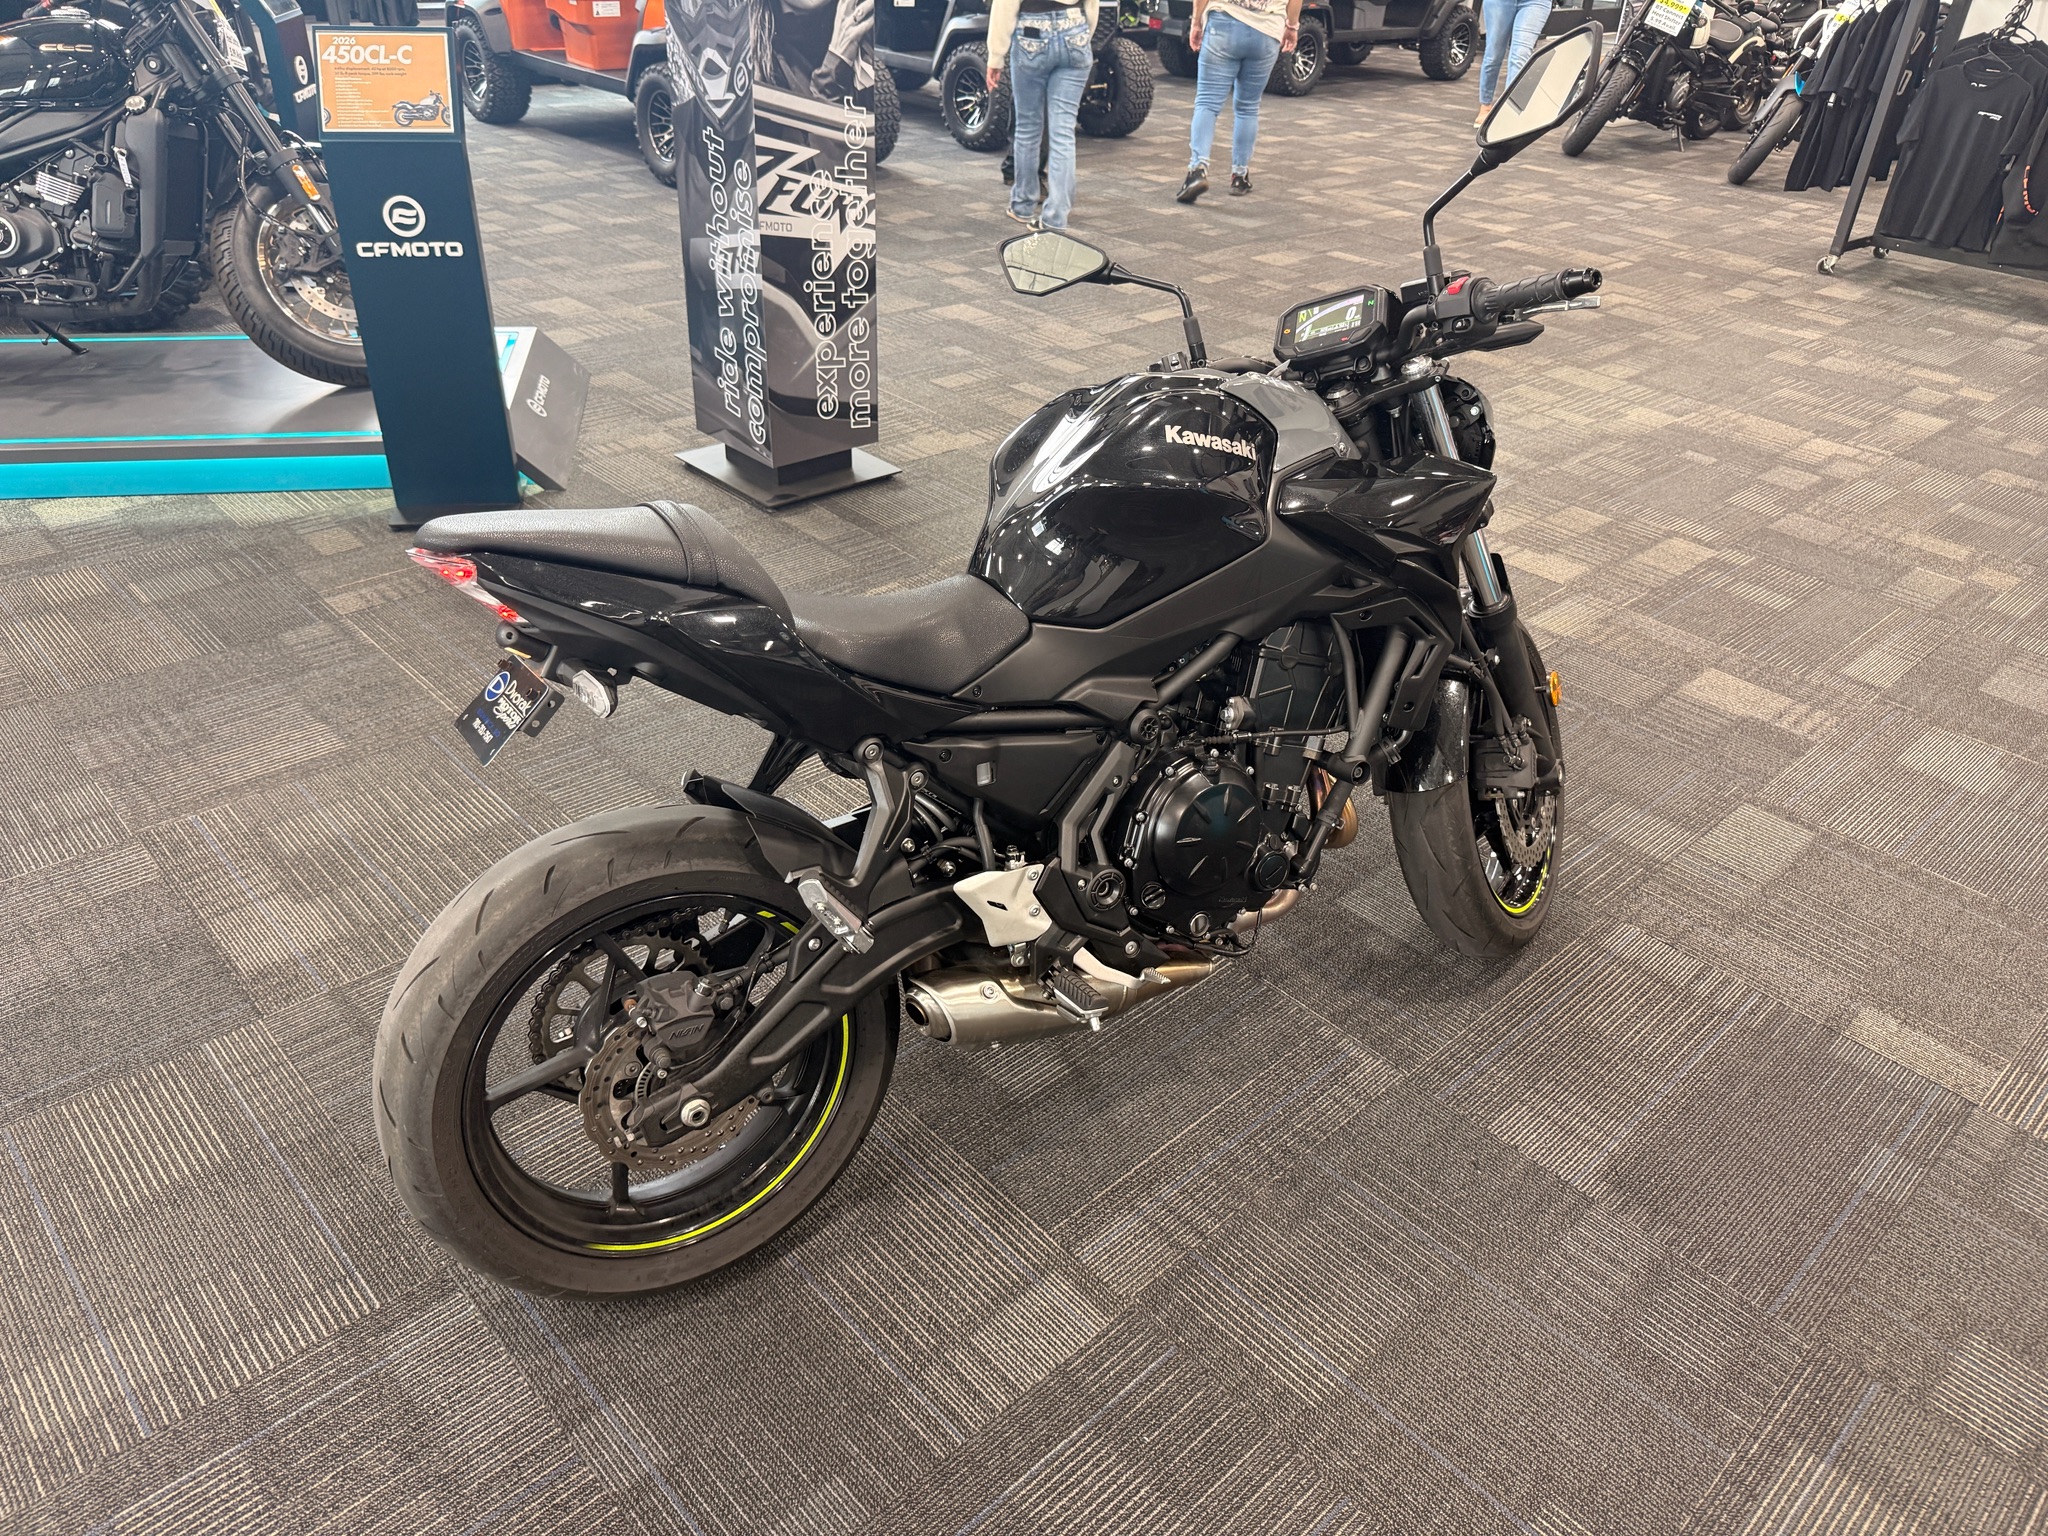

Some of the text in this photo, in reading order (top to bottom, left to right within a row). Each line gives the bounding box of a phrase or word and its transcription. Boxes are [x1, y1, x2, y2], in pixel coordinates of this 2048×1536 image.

[321, 44, 413, 65] 450CL-C
[332, 36, 356, 45] 2026
[356, 241, 464, 258] CFMOTO
[835, 96, 876, 429] more together
[702, 126, 741, 418] ride without
[730, 158, 767, 445] compromise
[803, 169, 847, 420] experience
[1164, 424, 1257, 461] Kawasaki
[504, 680, 532, 717] Dvorak
